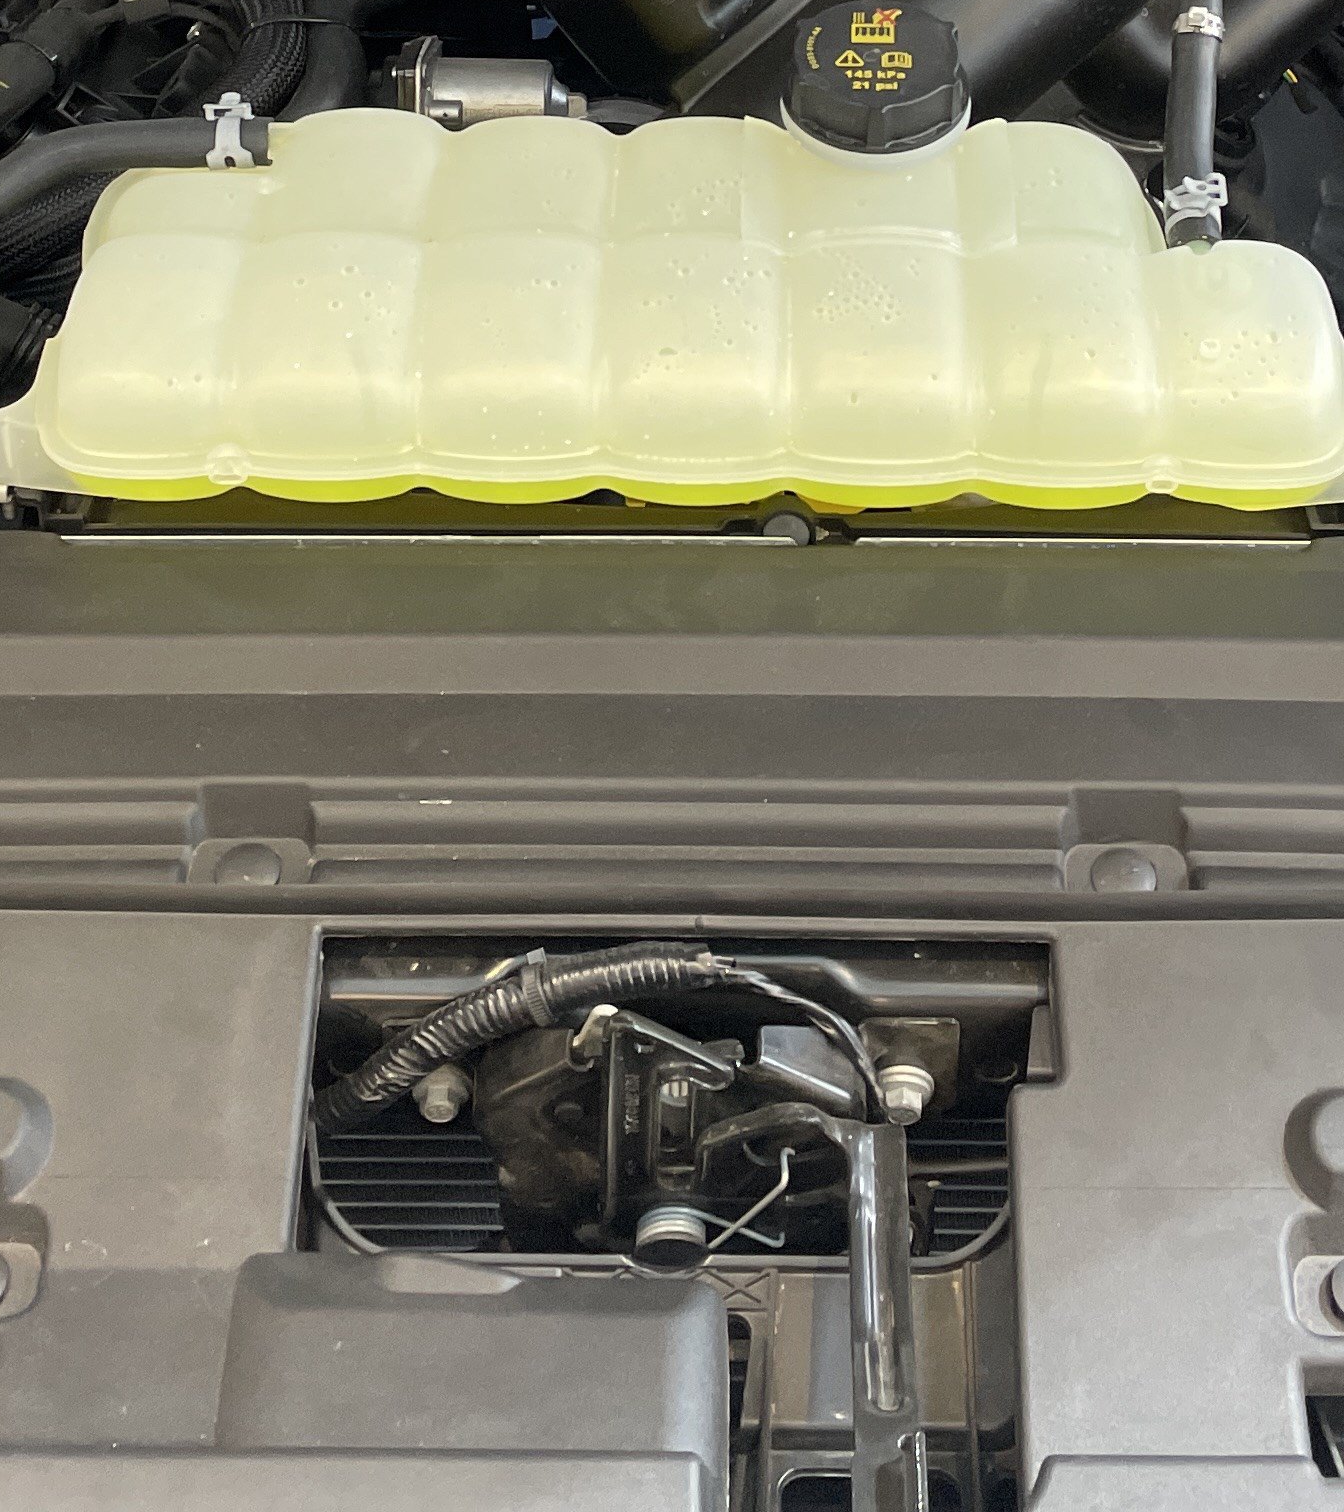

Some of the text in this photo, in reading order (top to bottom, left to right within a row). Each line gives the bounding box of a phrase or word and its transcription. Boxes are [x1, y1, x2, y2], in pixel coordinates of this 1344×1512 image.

[844, 69, 907, 80] 145 kPa
[851, 81, 899, 92] 21 psi
